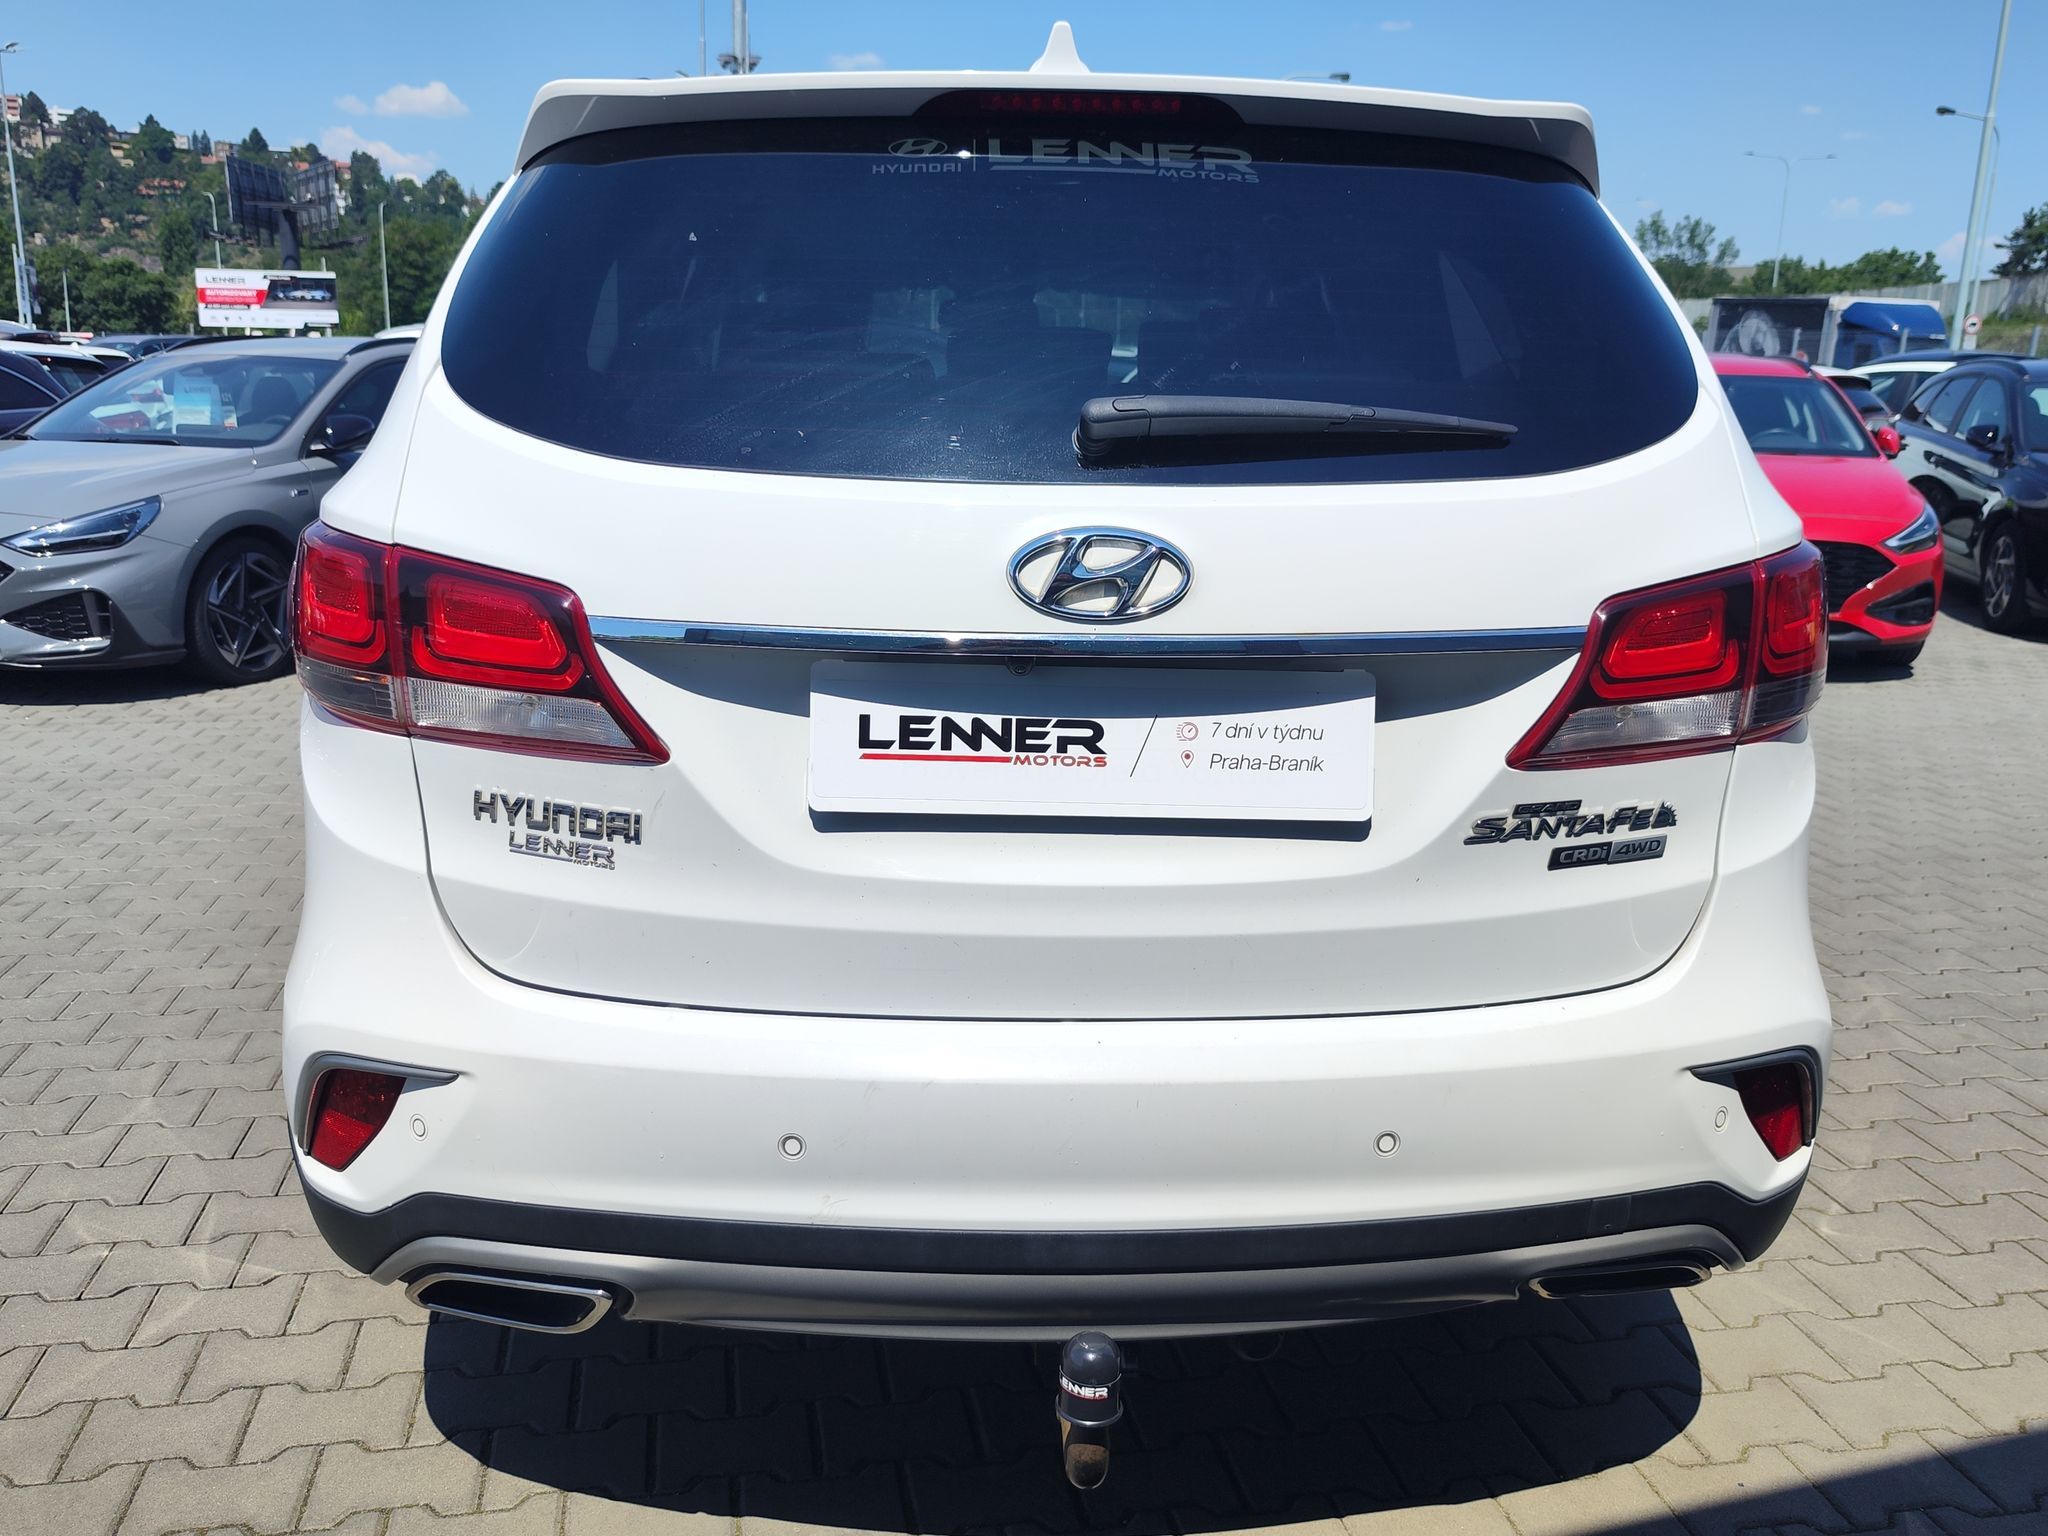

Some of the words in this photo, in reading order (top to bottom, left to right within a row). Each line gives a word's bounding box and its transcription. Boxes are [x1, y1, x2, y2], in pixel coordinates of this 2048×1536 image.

[988, 138, 1257, 174] LENNER
[872, 163, 962, 175] HYUNDAI
[1158, 169, 1260, 183] MOTORS
[858, 714, 1107, 755] LENNER
[1211, 722, 1222, 738] 7
[1225, 722, 1255, 739] dní
[1257, 727, 1269, 739] v
[1273, 723, 1324, 744] týdnu
[1012, 754, 1108, 768] MOTORS
[1210, 753, 1324, 772] Praha-Braník
[473, 786, 643, 845] HYUNDAI
[508, 830, 616, 864] LENNER
[1559, 845, 1608, 864] CRDi
[1614, 838, 1661, 857] 4WD
[572, 858, 616, 871] MOTORS
